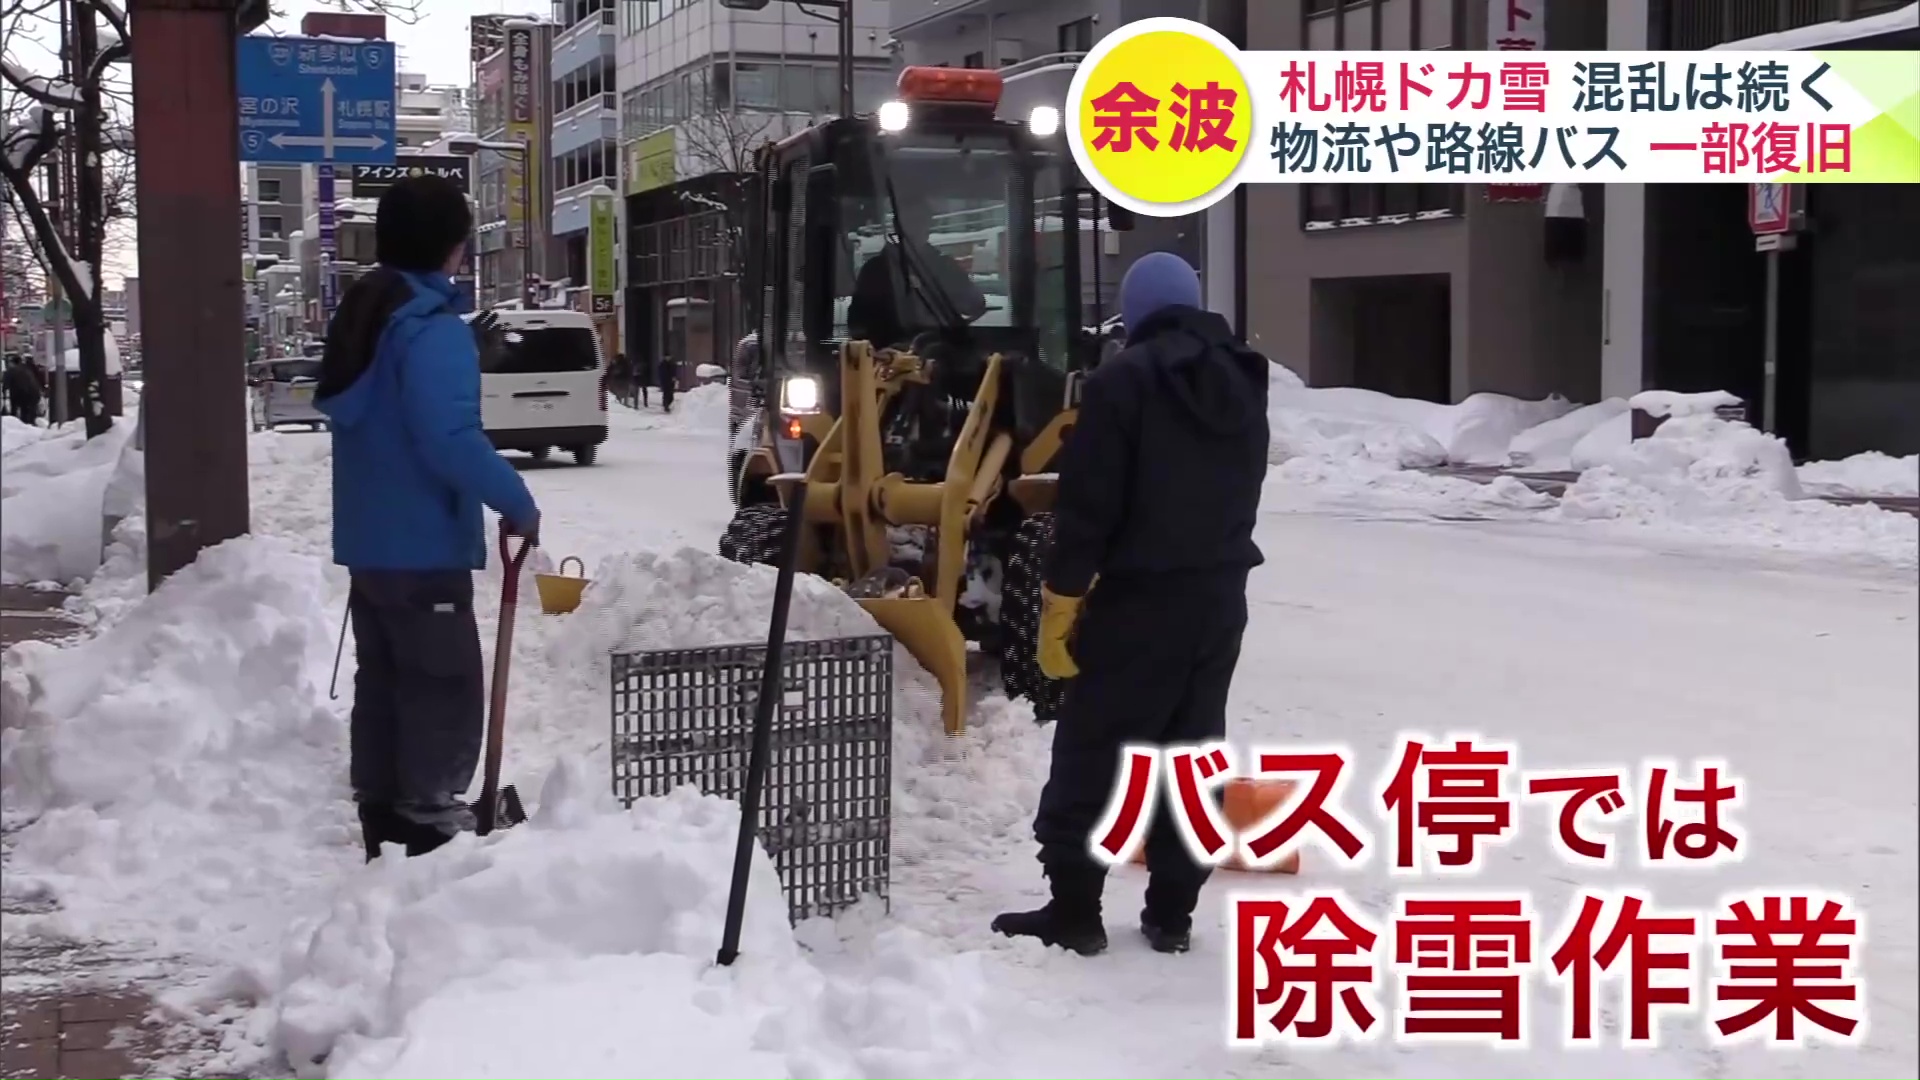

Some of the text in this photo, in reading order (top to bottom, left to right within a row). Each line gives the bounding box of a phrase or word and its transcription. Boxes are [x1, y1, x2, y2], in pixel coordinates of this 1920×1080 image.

[298, 44, 357, 63] 新琴似
[511, 32, 529, 121] 全身もみほぐし
[238, 97, 300, 115] 宮の沢
[337, 100, 391, 118] 札幌駅
